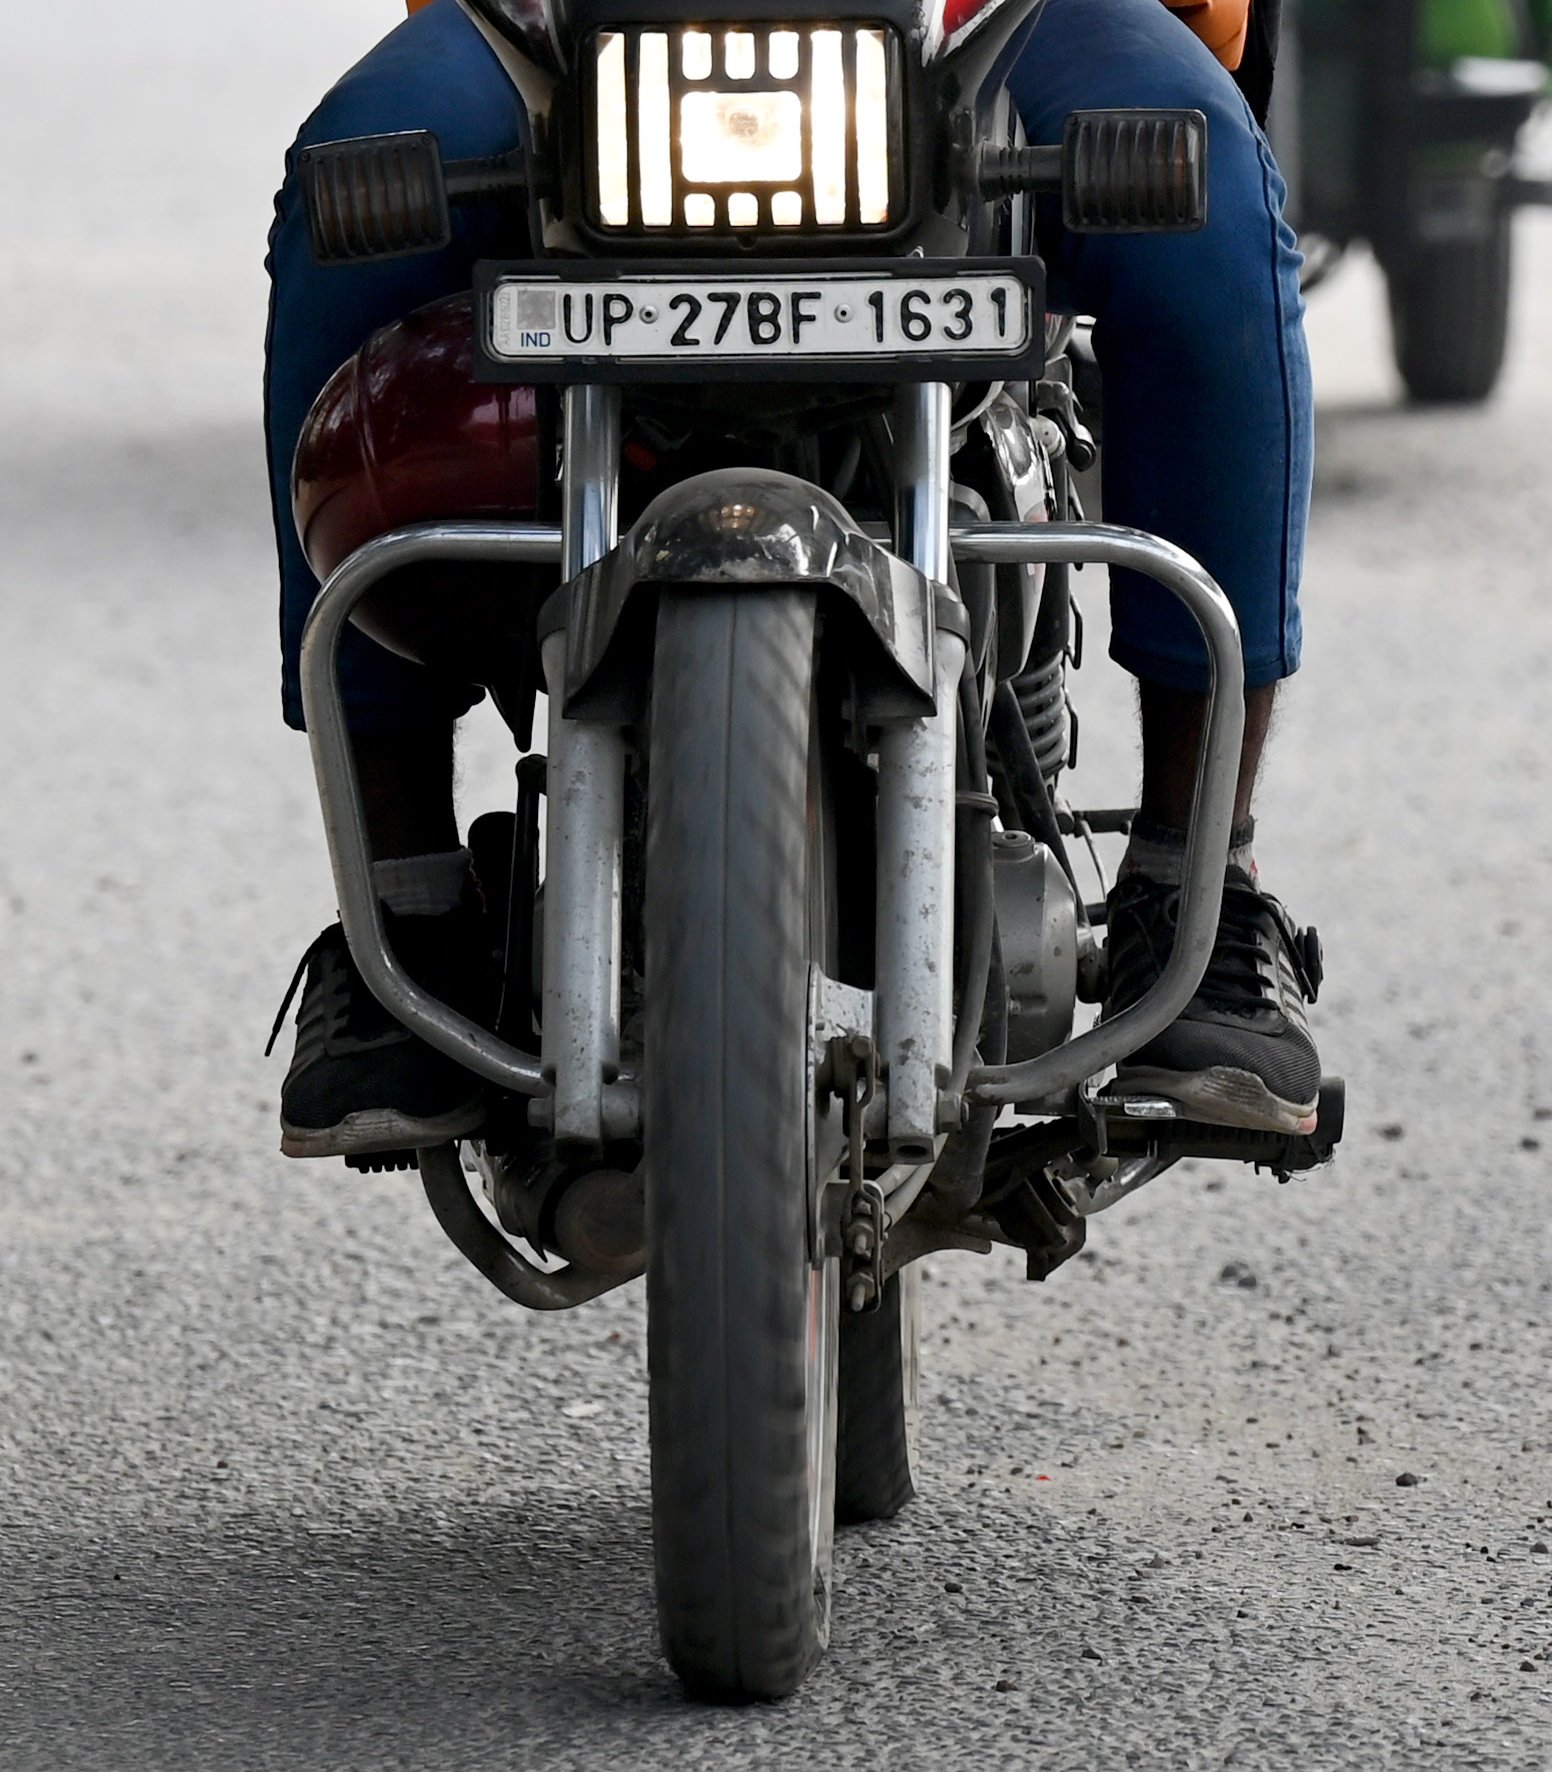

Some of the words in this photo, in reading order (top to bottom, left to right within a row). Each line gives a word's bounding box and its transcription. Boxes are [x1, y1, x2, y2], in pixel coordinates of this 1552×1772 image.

[563, 293, 634, 346] UP
[669, 291, 822, 347] 27BF
[868, 287, 1006, 344] 1631
[520, 331, 551, 348] IND
